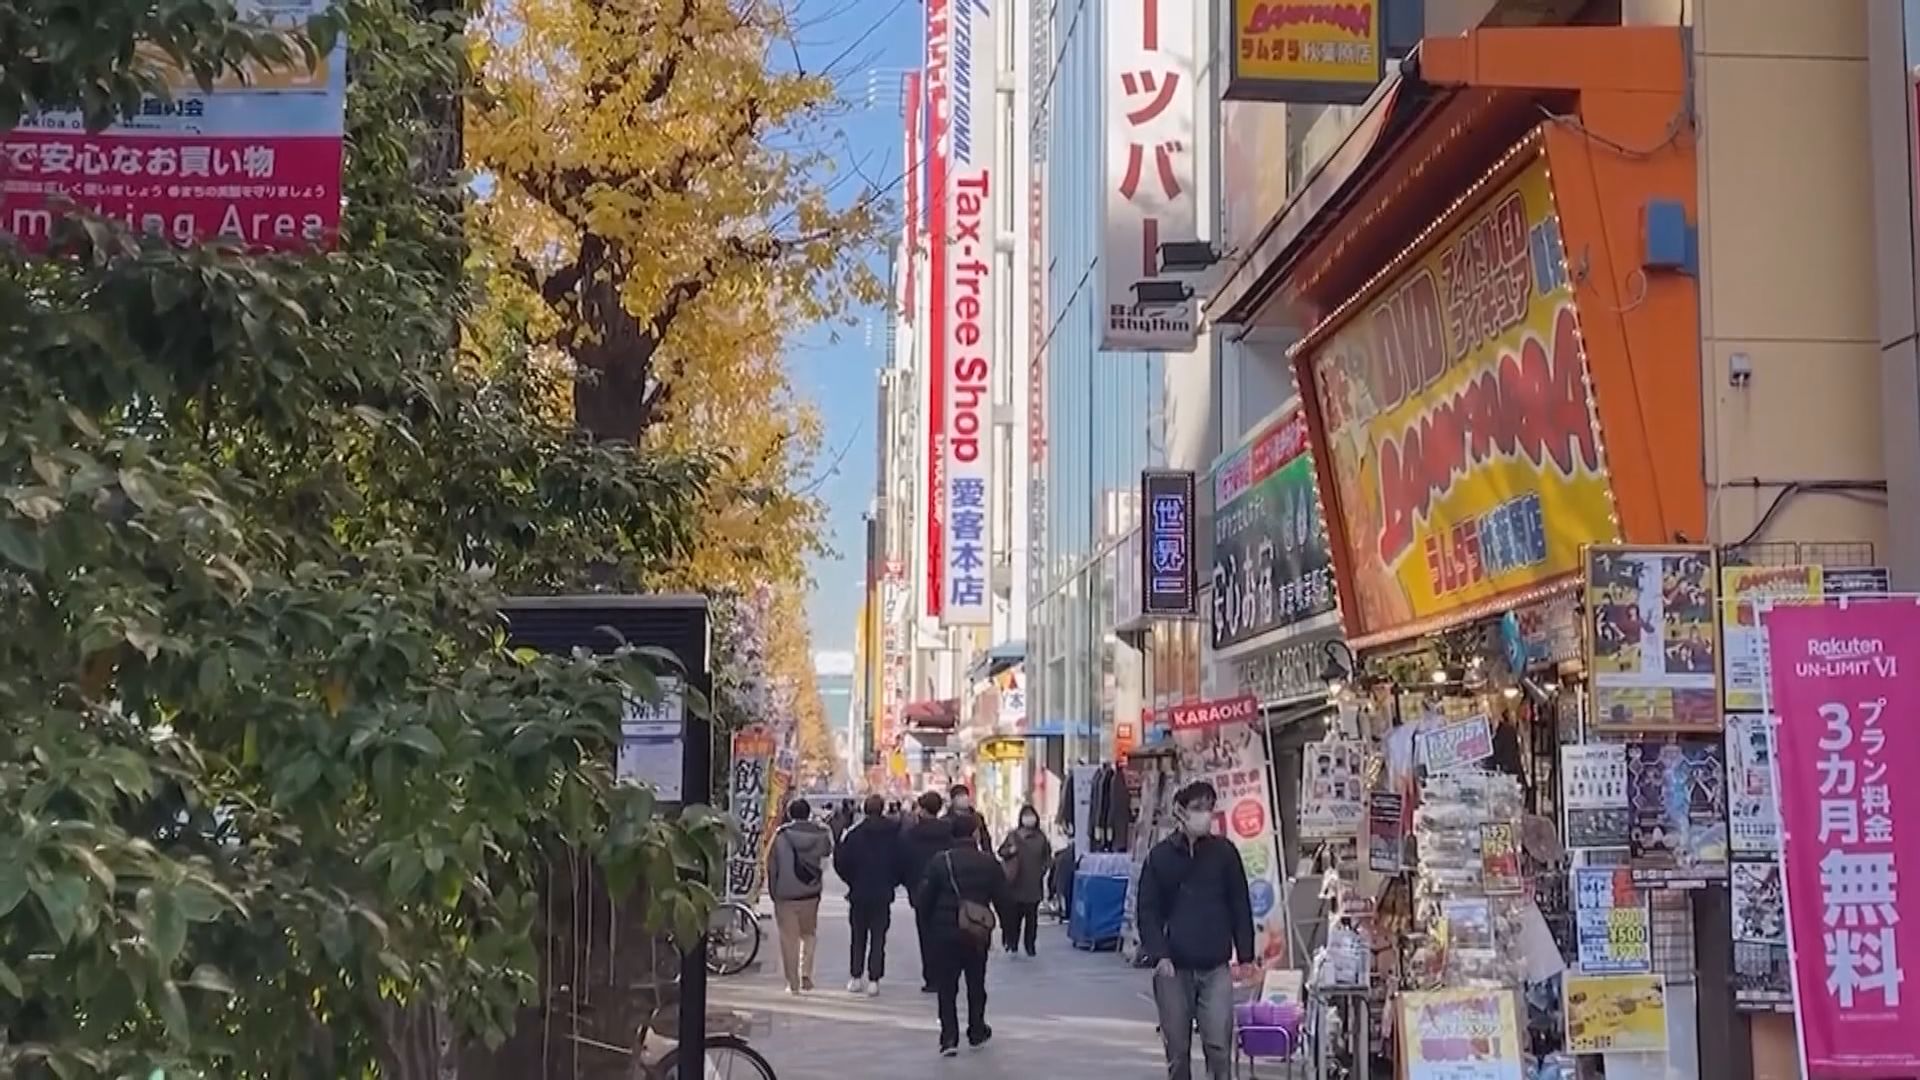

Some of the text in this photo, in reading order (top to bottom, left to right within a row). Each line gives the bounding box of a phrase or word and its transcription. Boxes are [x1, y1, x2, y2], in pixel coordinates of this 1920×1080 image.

[0, 141, 276, 178] で安心なお買い物
[218, 203, 324, 240] Area
[951, 169, 989, 463] Tax-free Shop
[1110, 317, 1190, 335] Rhythm
[1370, 268, 1447, 415] DVD
[950, 477, 986, 607] 愛客本店
[1807, 637, 1883, 657] Rakuten
[1795, 656, 1898, 678] UN-LIMIT VI
[1173, 702, 1253, 726] KARAOKE
[1858, 697, 1894, 844] プラン料金
[1818, 848, 1905, 1008] 無料
